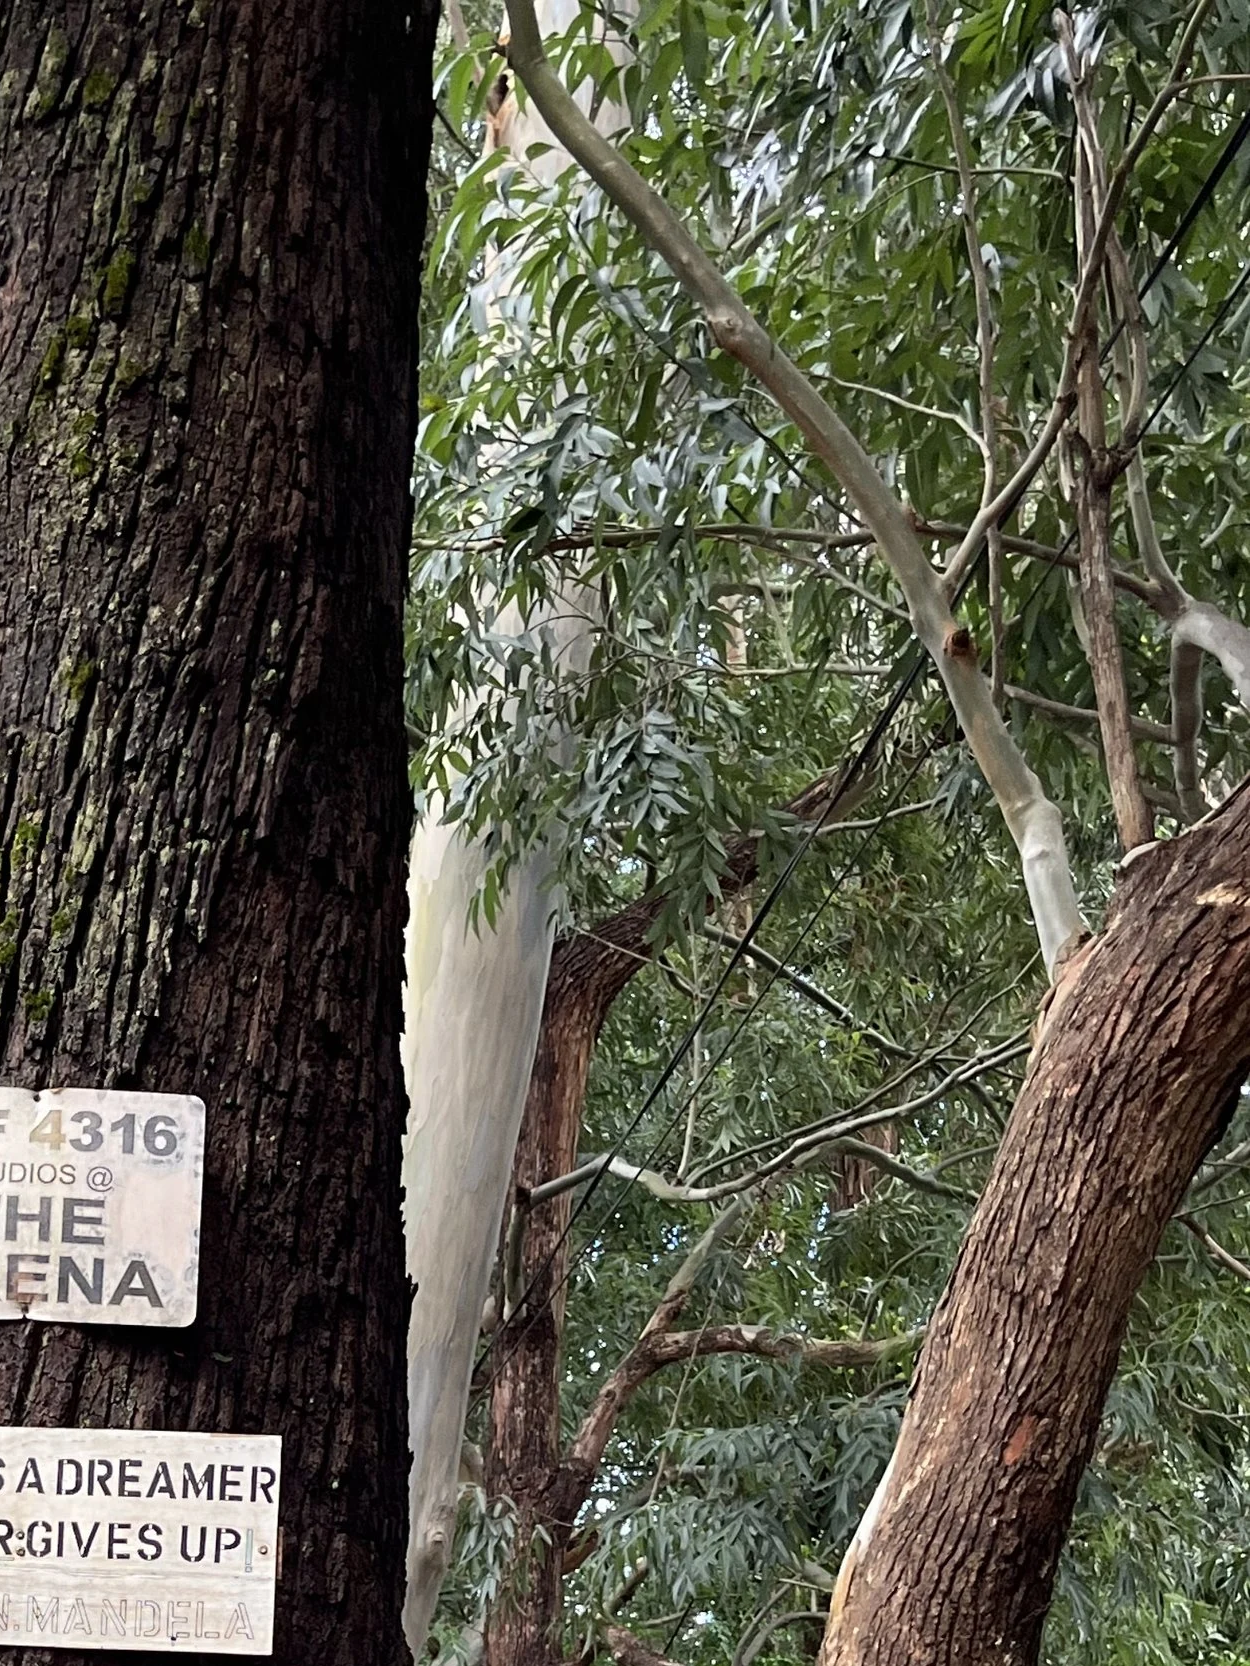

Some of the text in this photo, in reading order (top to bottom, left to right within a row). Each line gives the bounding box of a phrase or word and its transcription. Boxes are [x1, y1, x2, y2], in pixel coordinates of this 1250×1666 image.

[29, 1109, 178, 1157] 4316
[86, 1166, 114, 1193] @
[15, 1457, 45, 1495] A
[56, 1458, 277, 1504] DREAMER
[25, 1520, 163, 1562] GIVES
